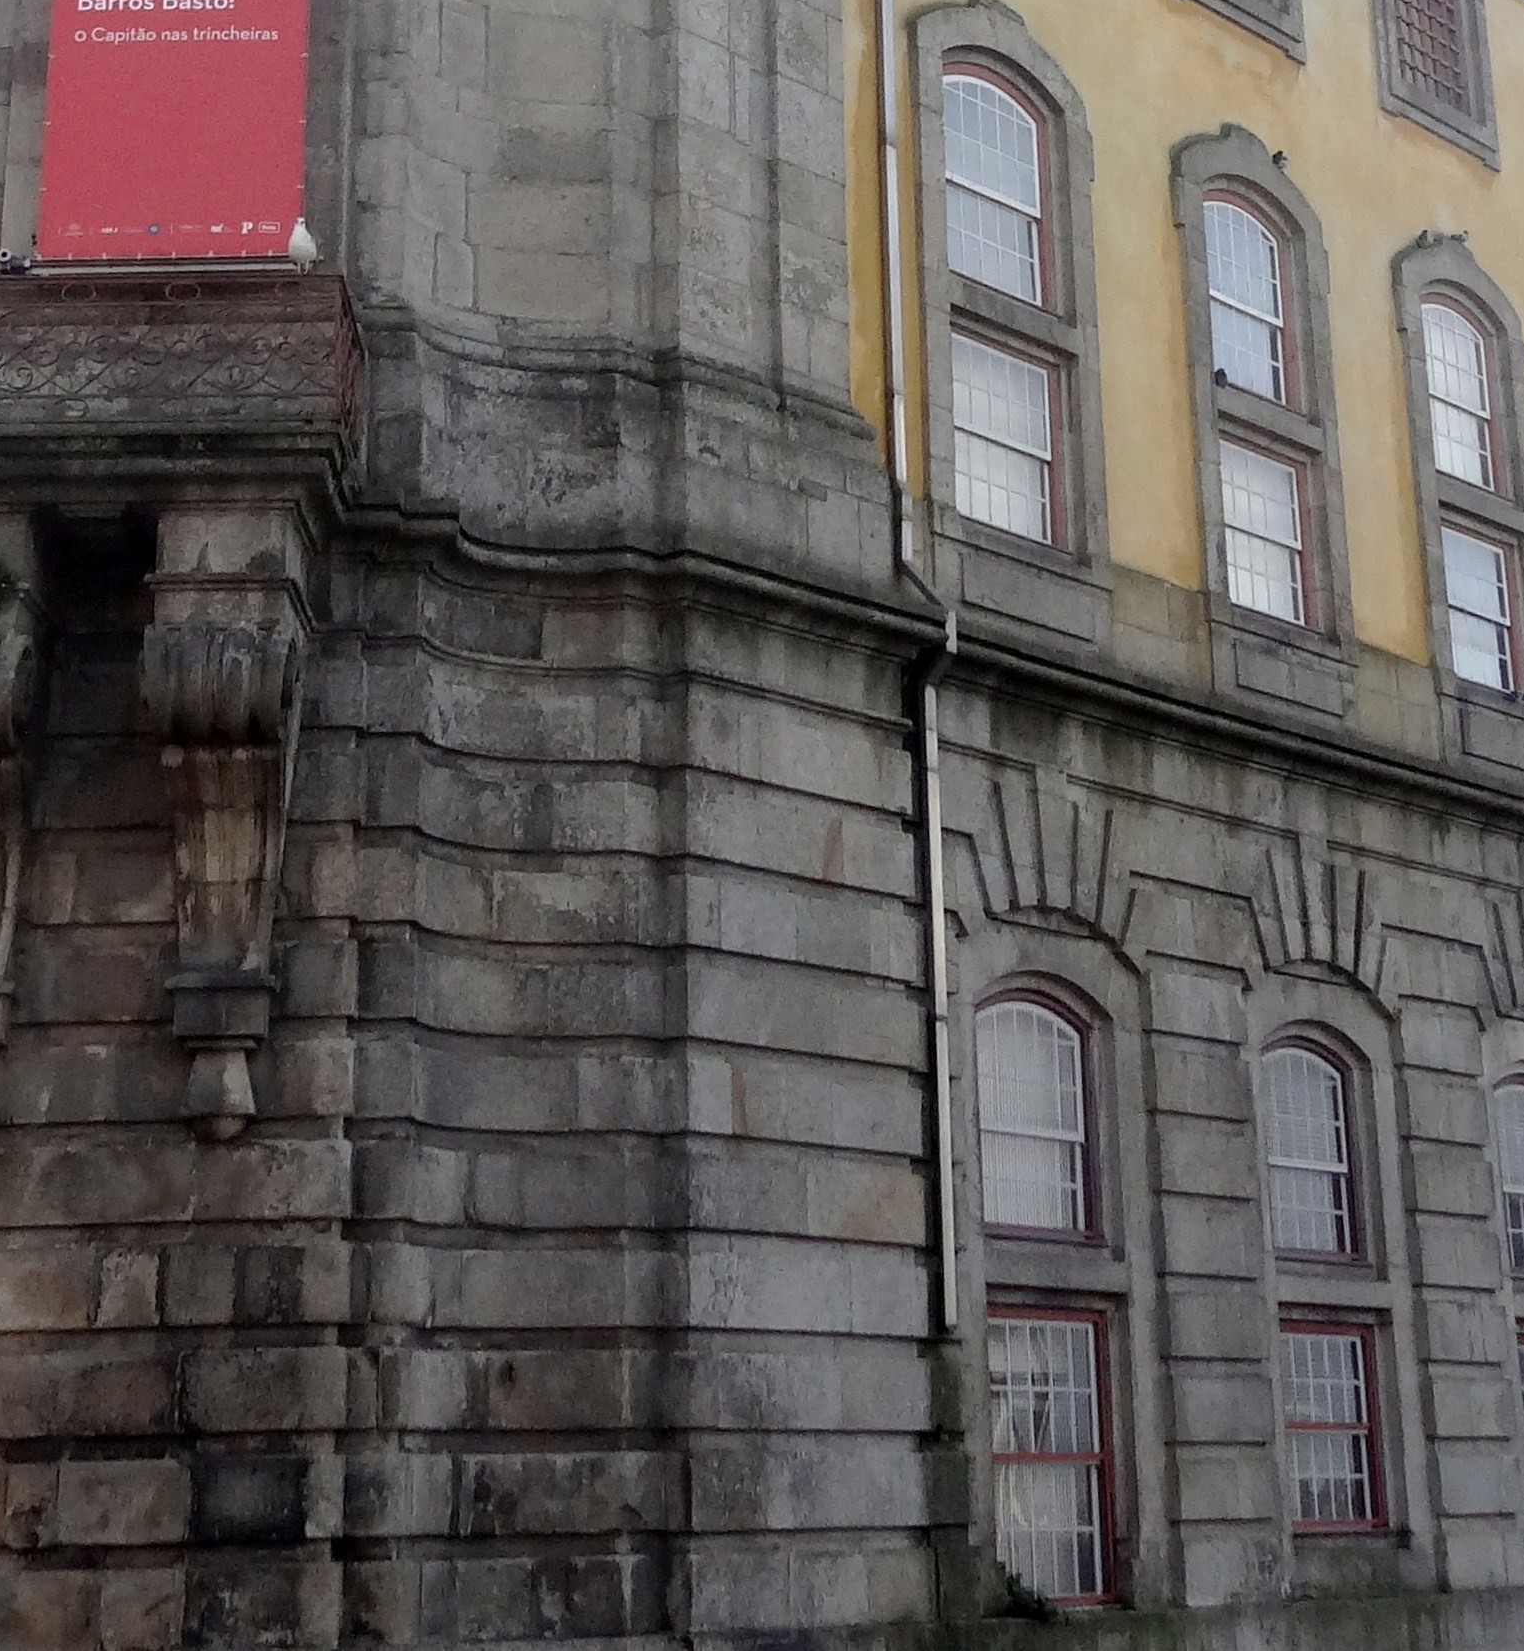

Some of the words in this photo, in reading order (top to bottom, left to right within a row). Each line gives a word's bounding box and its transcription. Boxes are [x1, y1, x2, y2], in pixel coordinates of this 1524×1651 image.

[74, 30, 87, 42] o
[91, 27, 157, 44] Capitão
[161, 30, 188, 41] nas
[193, 25, 279, 41] trincheiras
